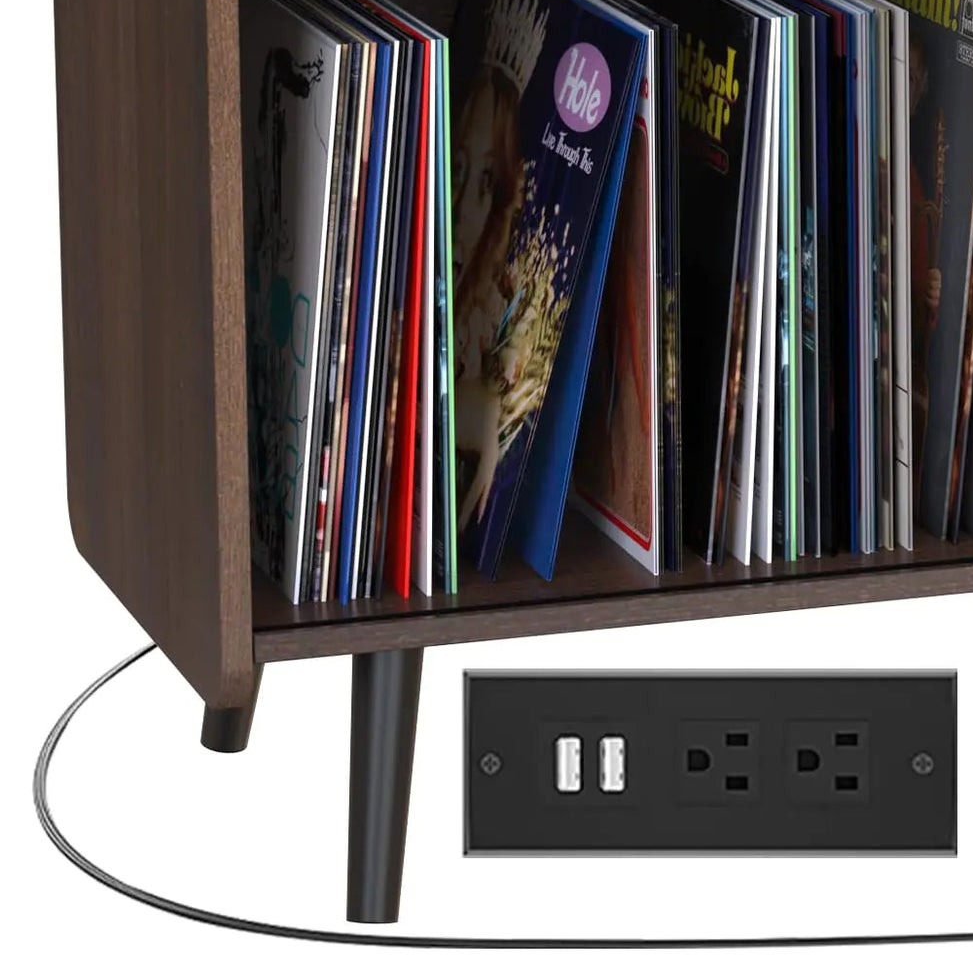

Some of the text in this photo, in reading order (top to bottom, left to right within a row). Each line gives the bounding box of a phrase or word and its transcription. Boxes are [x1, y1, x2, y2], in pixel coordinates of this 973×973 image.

[559, 47, 602, 124] Hole
[541, 121, 594, 175] Live Through This
